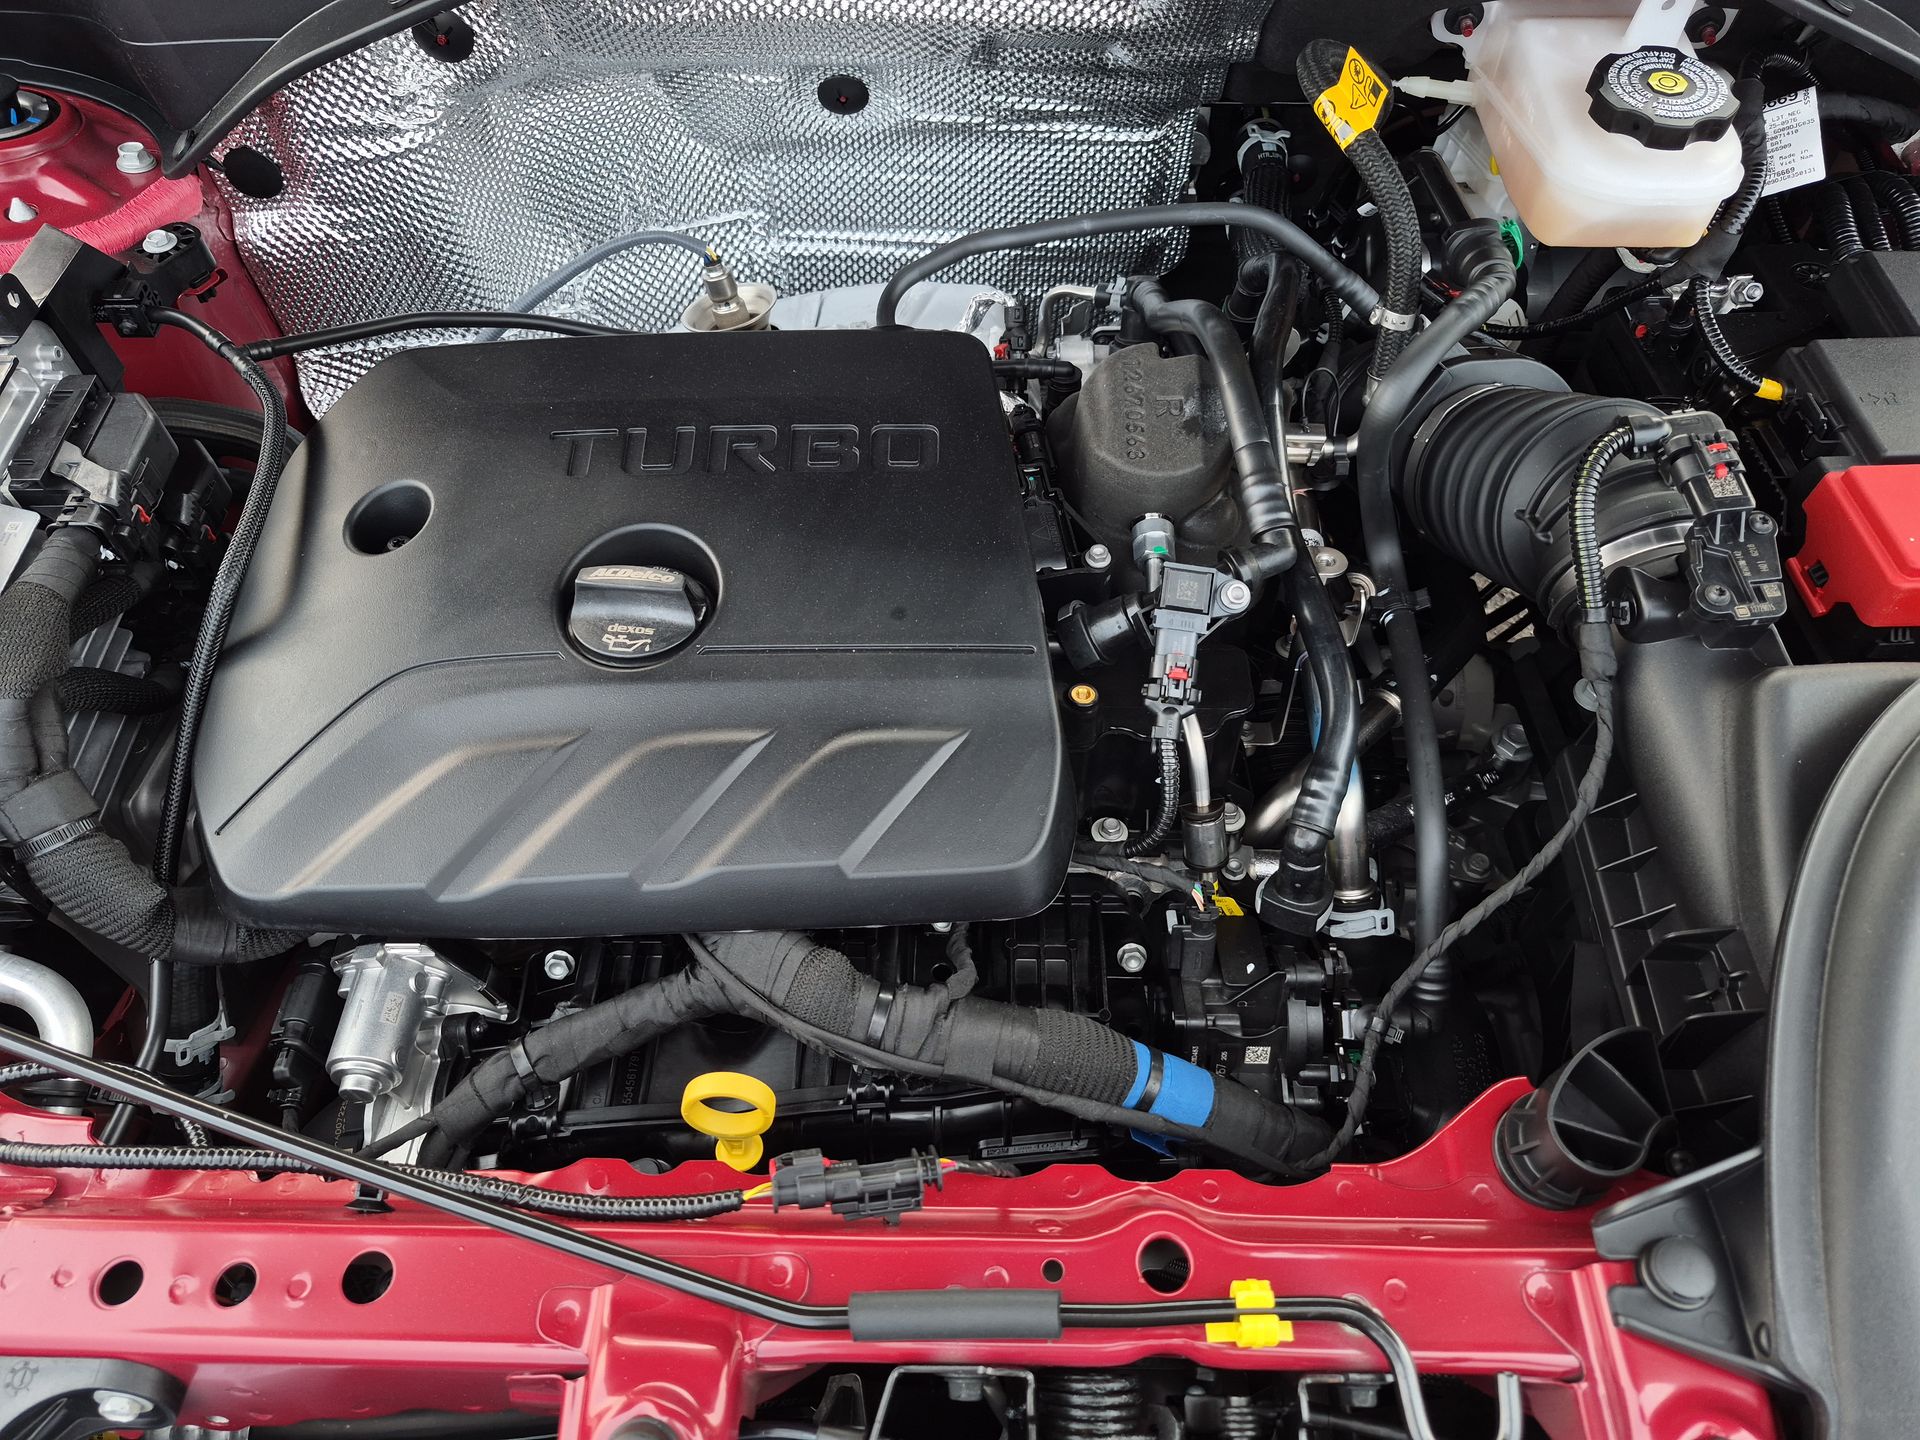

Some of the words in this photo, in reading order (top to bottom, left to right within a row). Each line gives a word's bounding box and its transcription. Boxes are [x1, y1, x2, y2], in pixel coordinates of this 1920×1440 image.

[1156, 395, 1184, 418] R
[550, 423, 940, 477] TURBO
[588, 567, 677, 583] ACDelco
[607, 623, 657, 636] dexos
